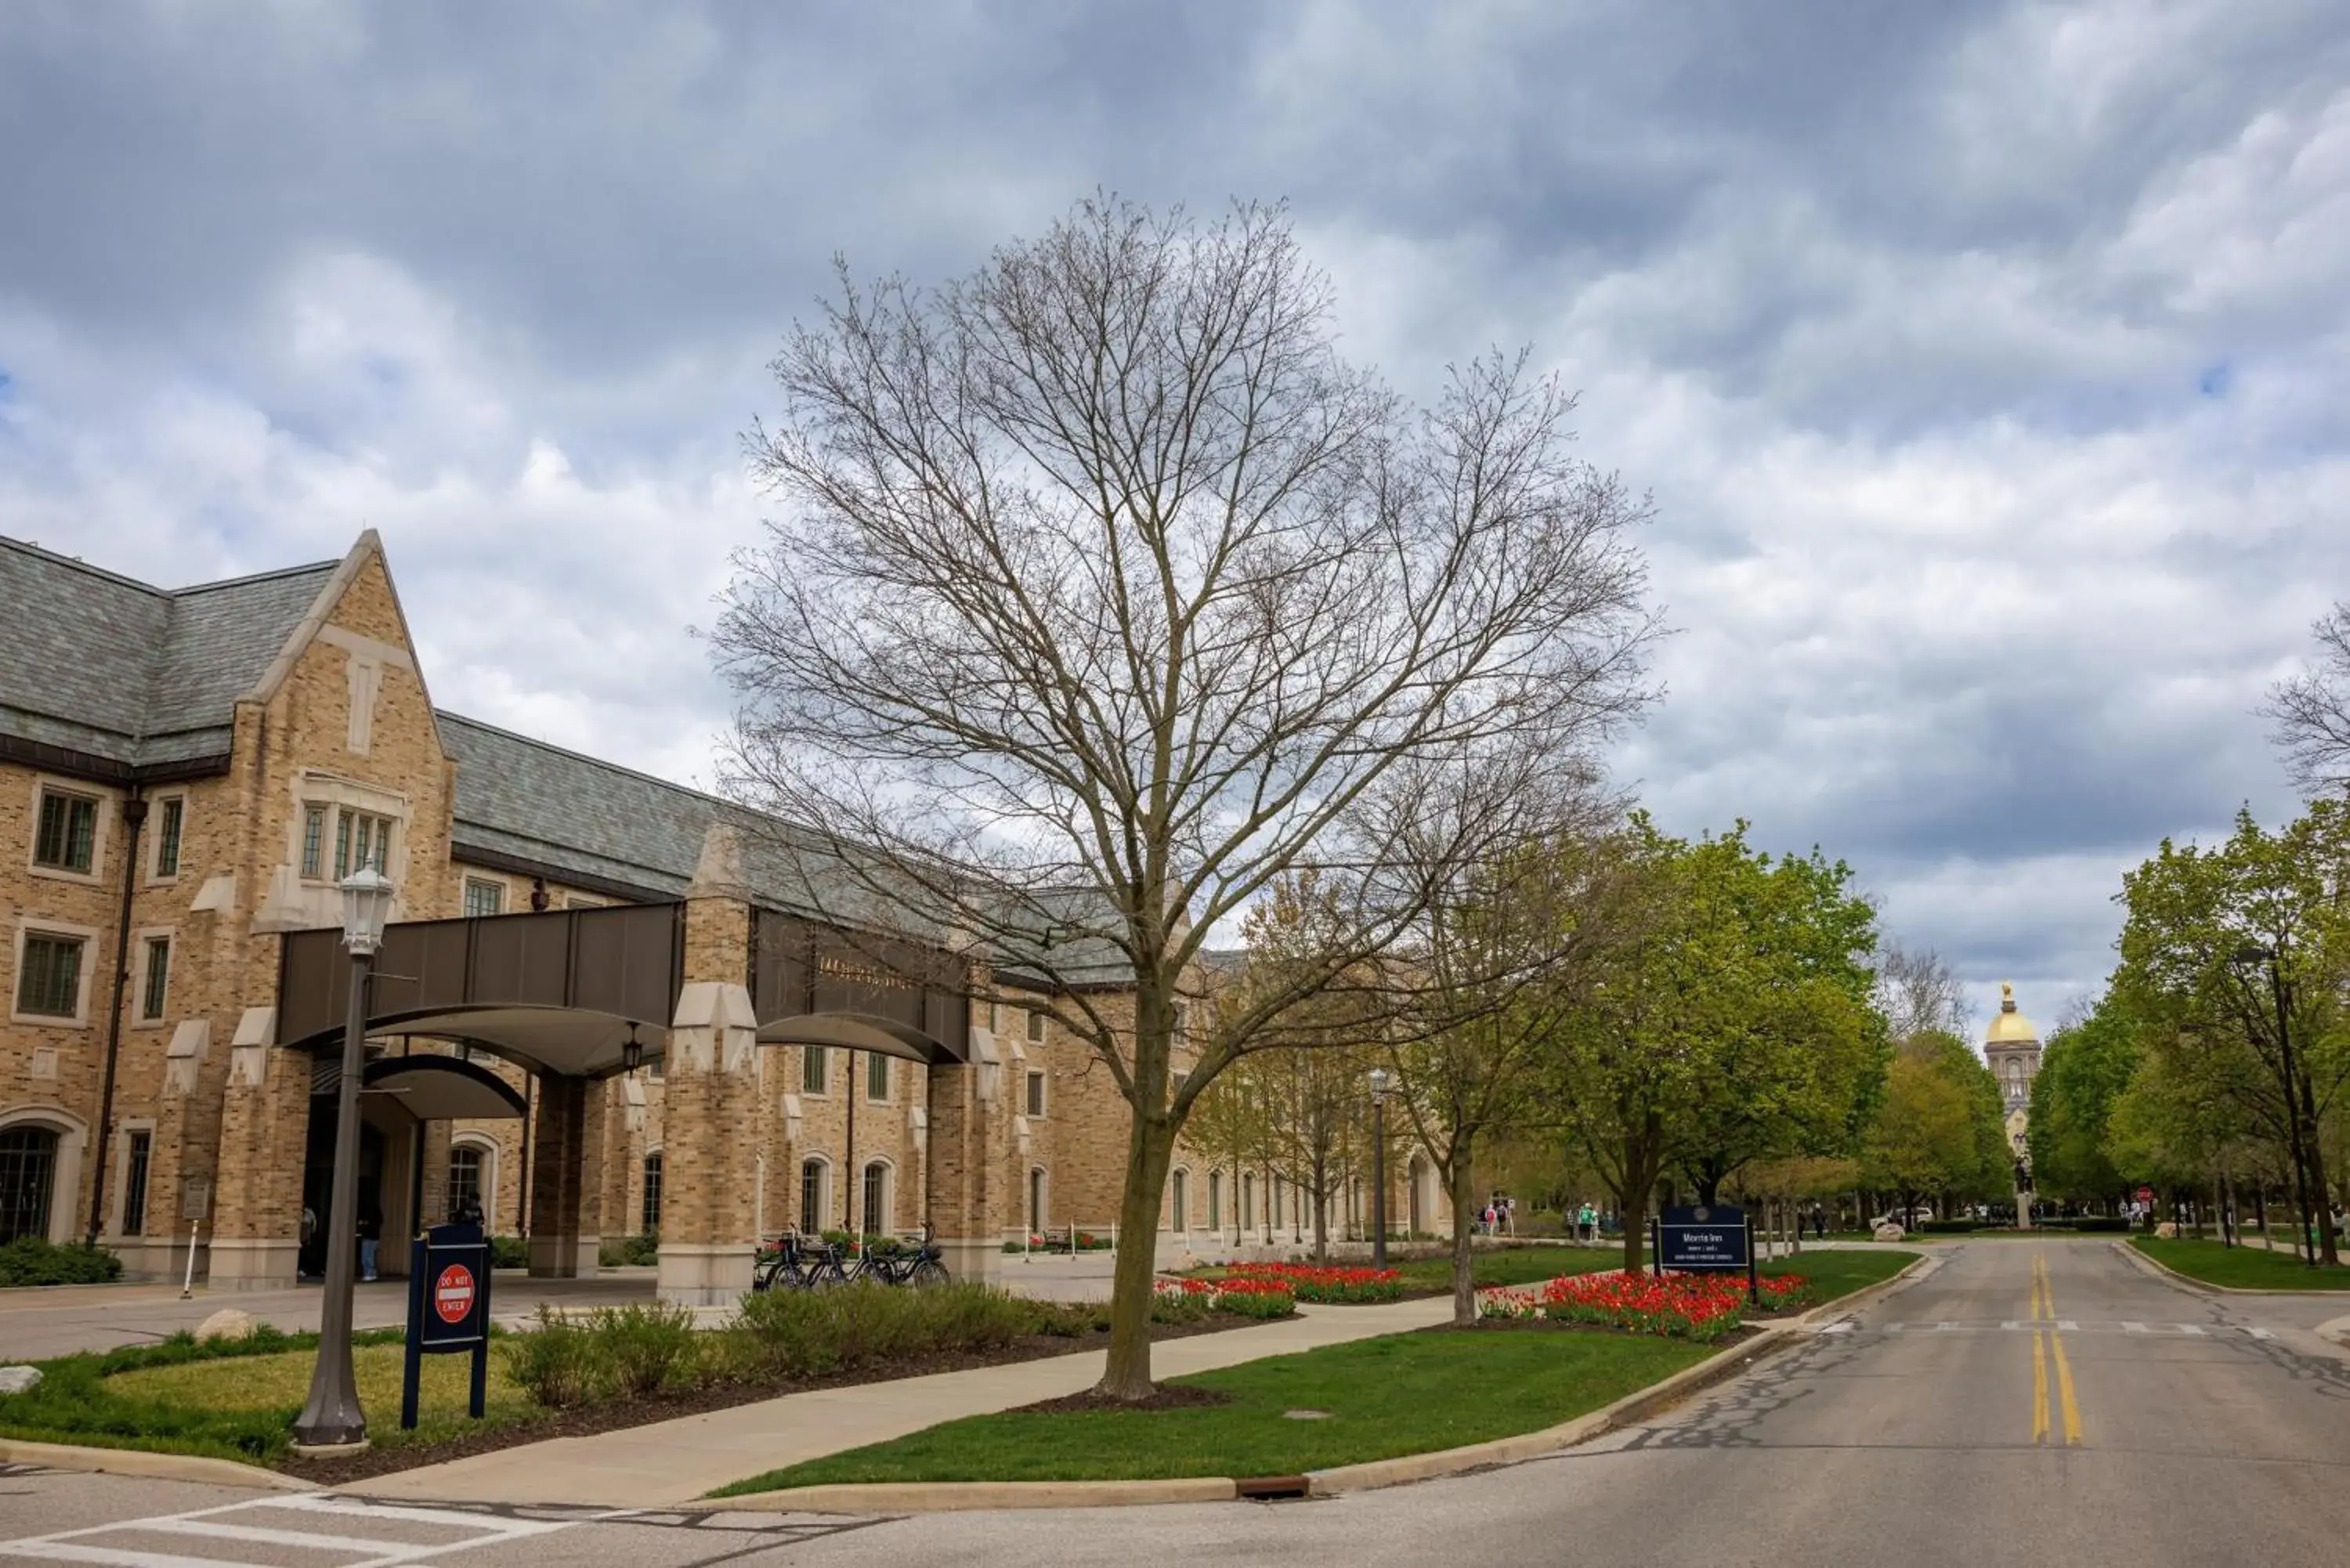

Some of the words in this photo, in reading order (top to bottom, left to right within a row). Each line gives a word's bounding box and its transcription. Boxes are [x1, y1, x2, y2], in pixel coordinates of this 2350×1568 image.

[1683, 1233, 1708, 1242] Morris
[441, 1276, 452, 1286] DO
[455, 1275, 468, 1285] NOT
[442, 1301, 465, 1312] ENTER
